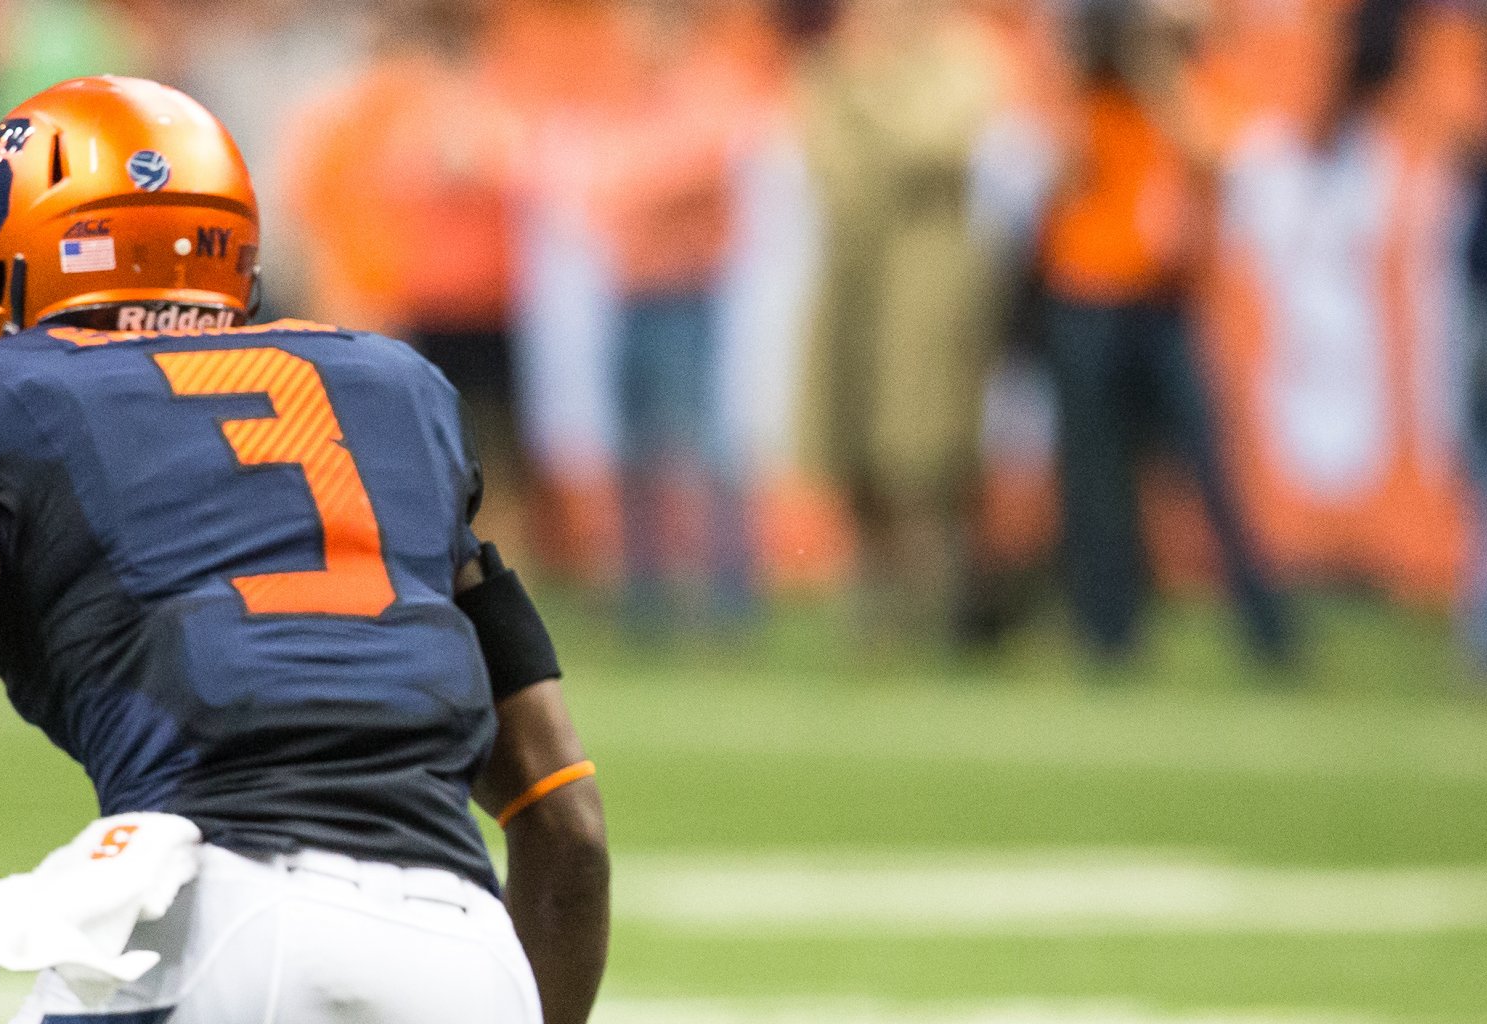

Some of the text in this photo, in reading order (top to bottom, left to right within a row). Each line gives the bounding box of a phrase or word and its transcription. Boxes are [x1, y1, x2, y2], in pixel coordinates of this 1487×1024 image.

[196, 227, 233, 258] NY
[117, 302, 235, 331] Riddell
[153, 347, 397, 618] 3
